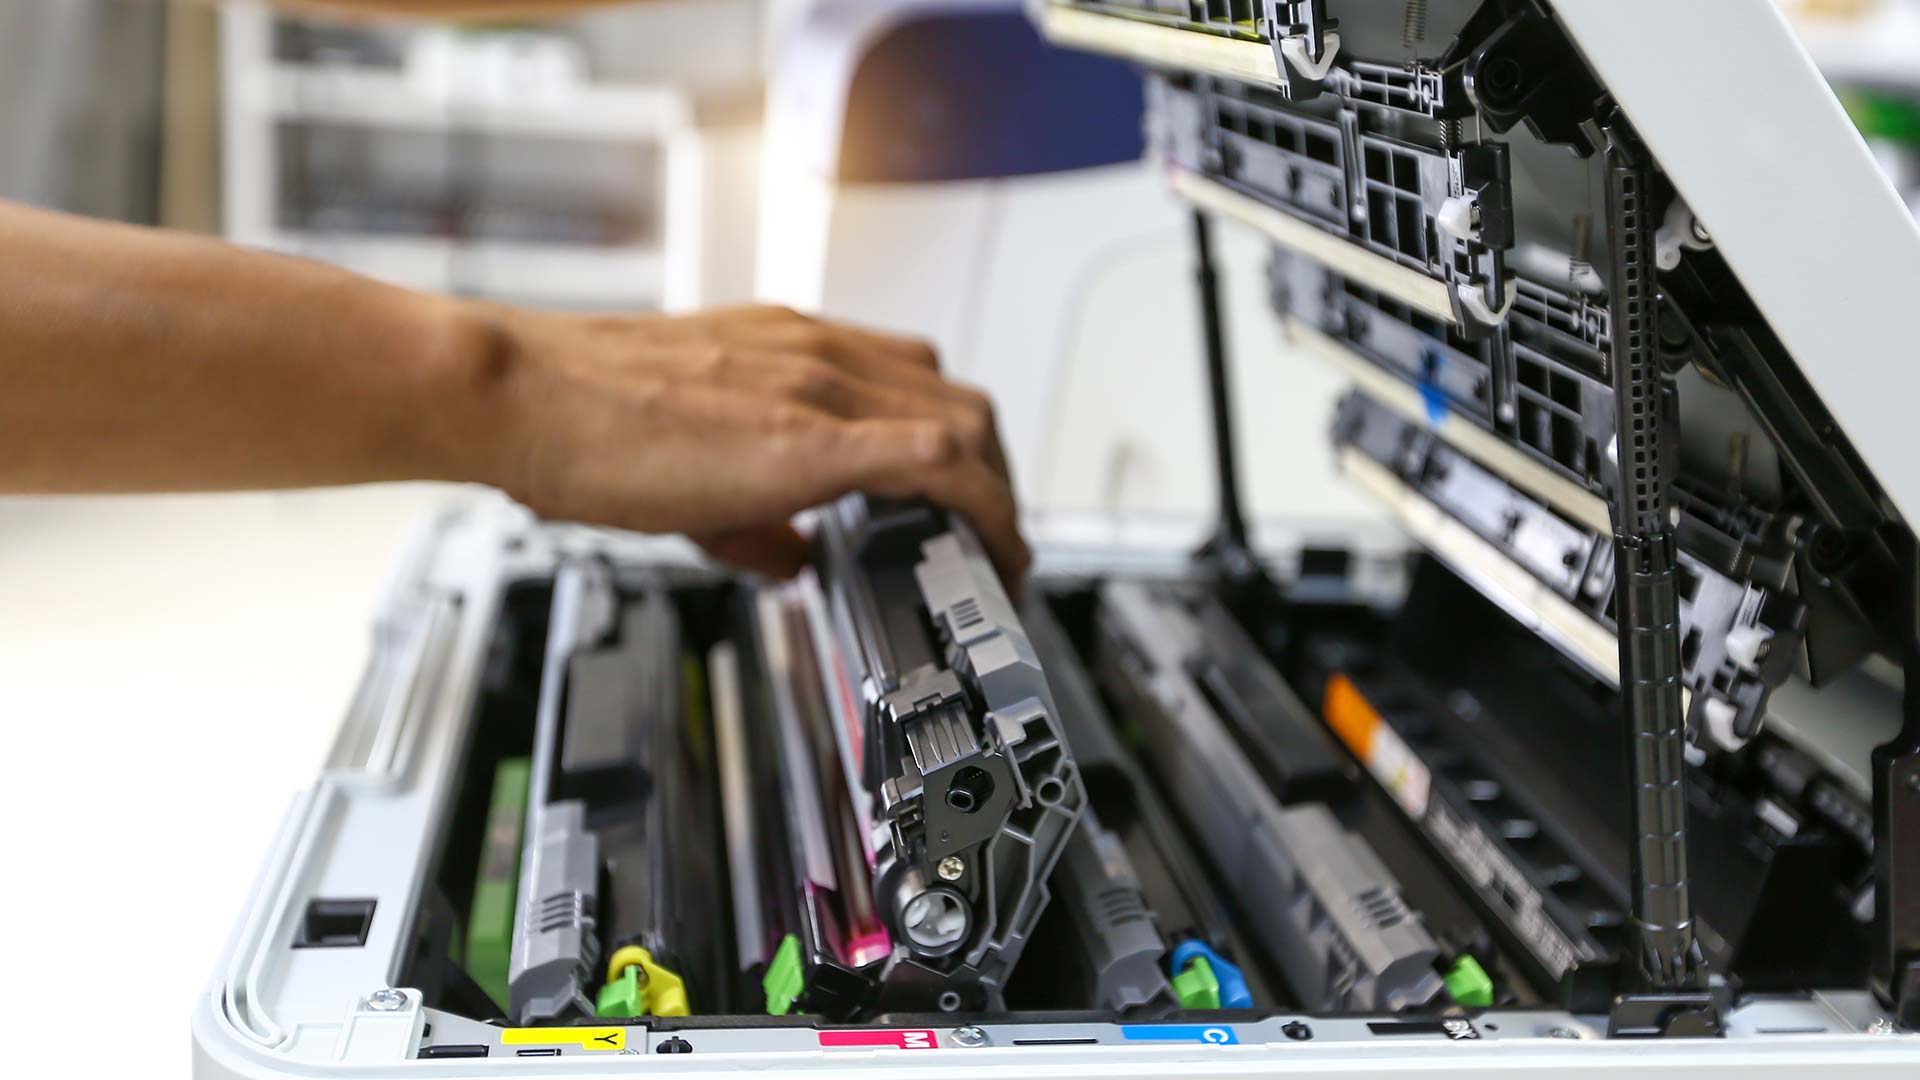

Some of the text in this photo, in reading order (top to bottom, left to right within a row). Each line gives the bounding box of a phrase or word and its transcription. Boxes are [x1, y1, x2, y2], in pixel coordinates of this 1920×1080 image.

[594, 1033, 618, 1045] Y
[903, 1032, 930, 1048] M
[1203, 1028, 1229, 1043] C
